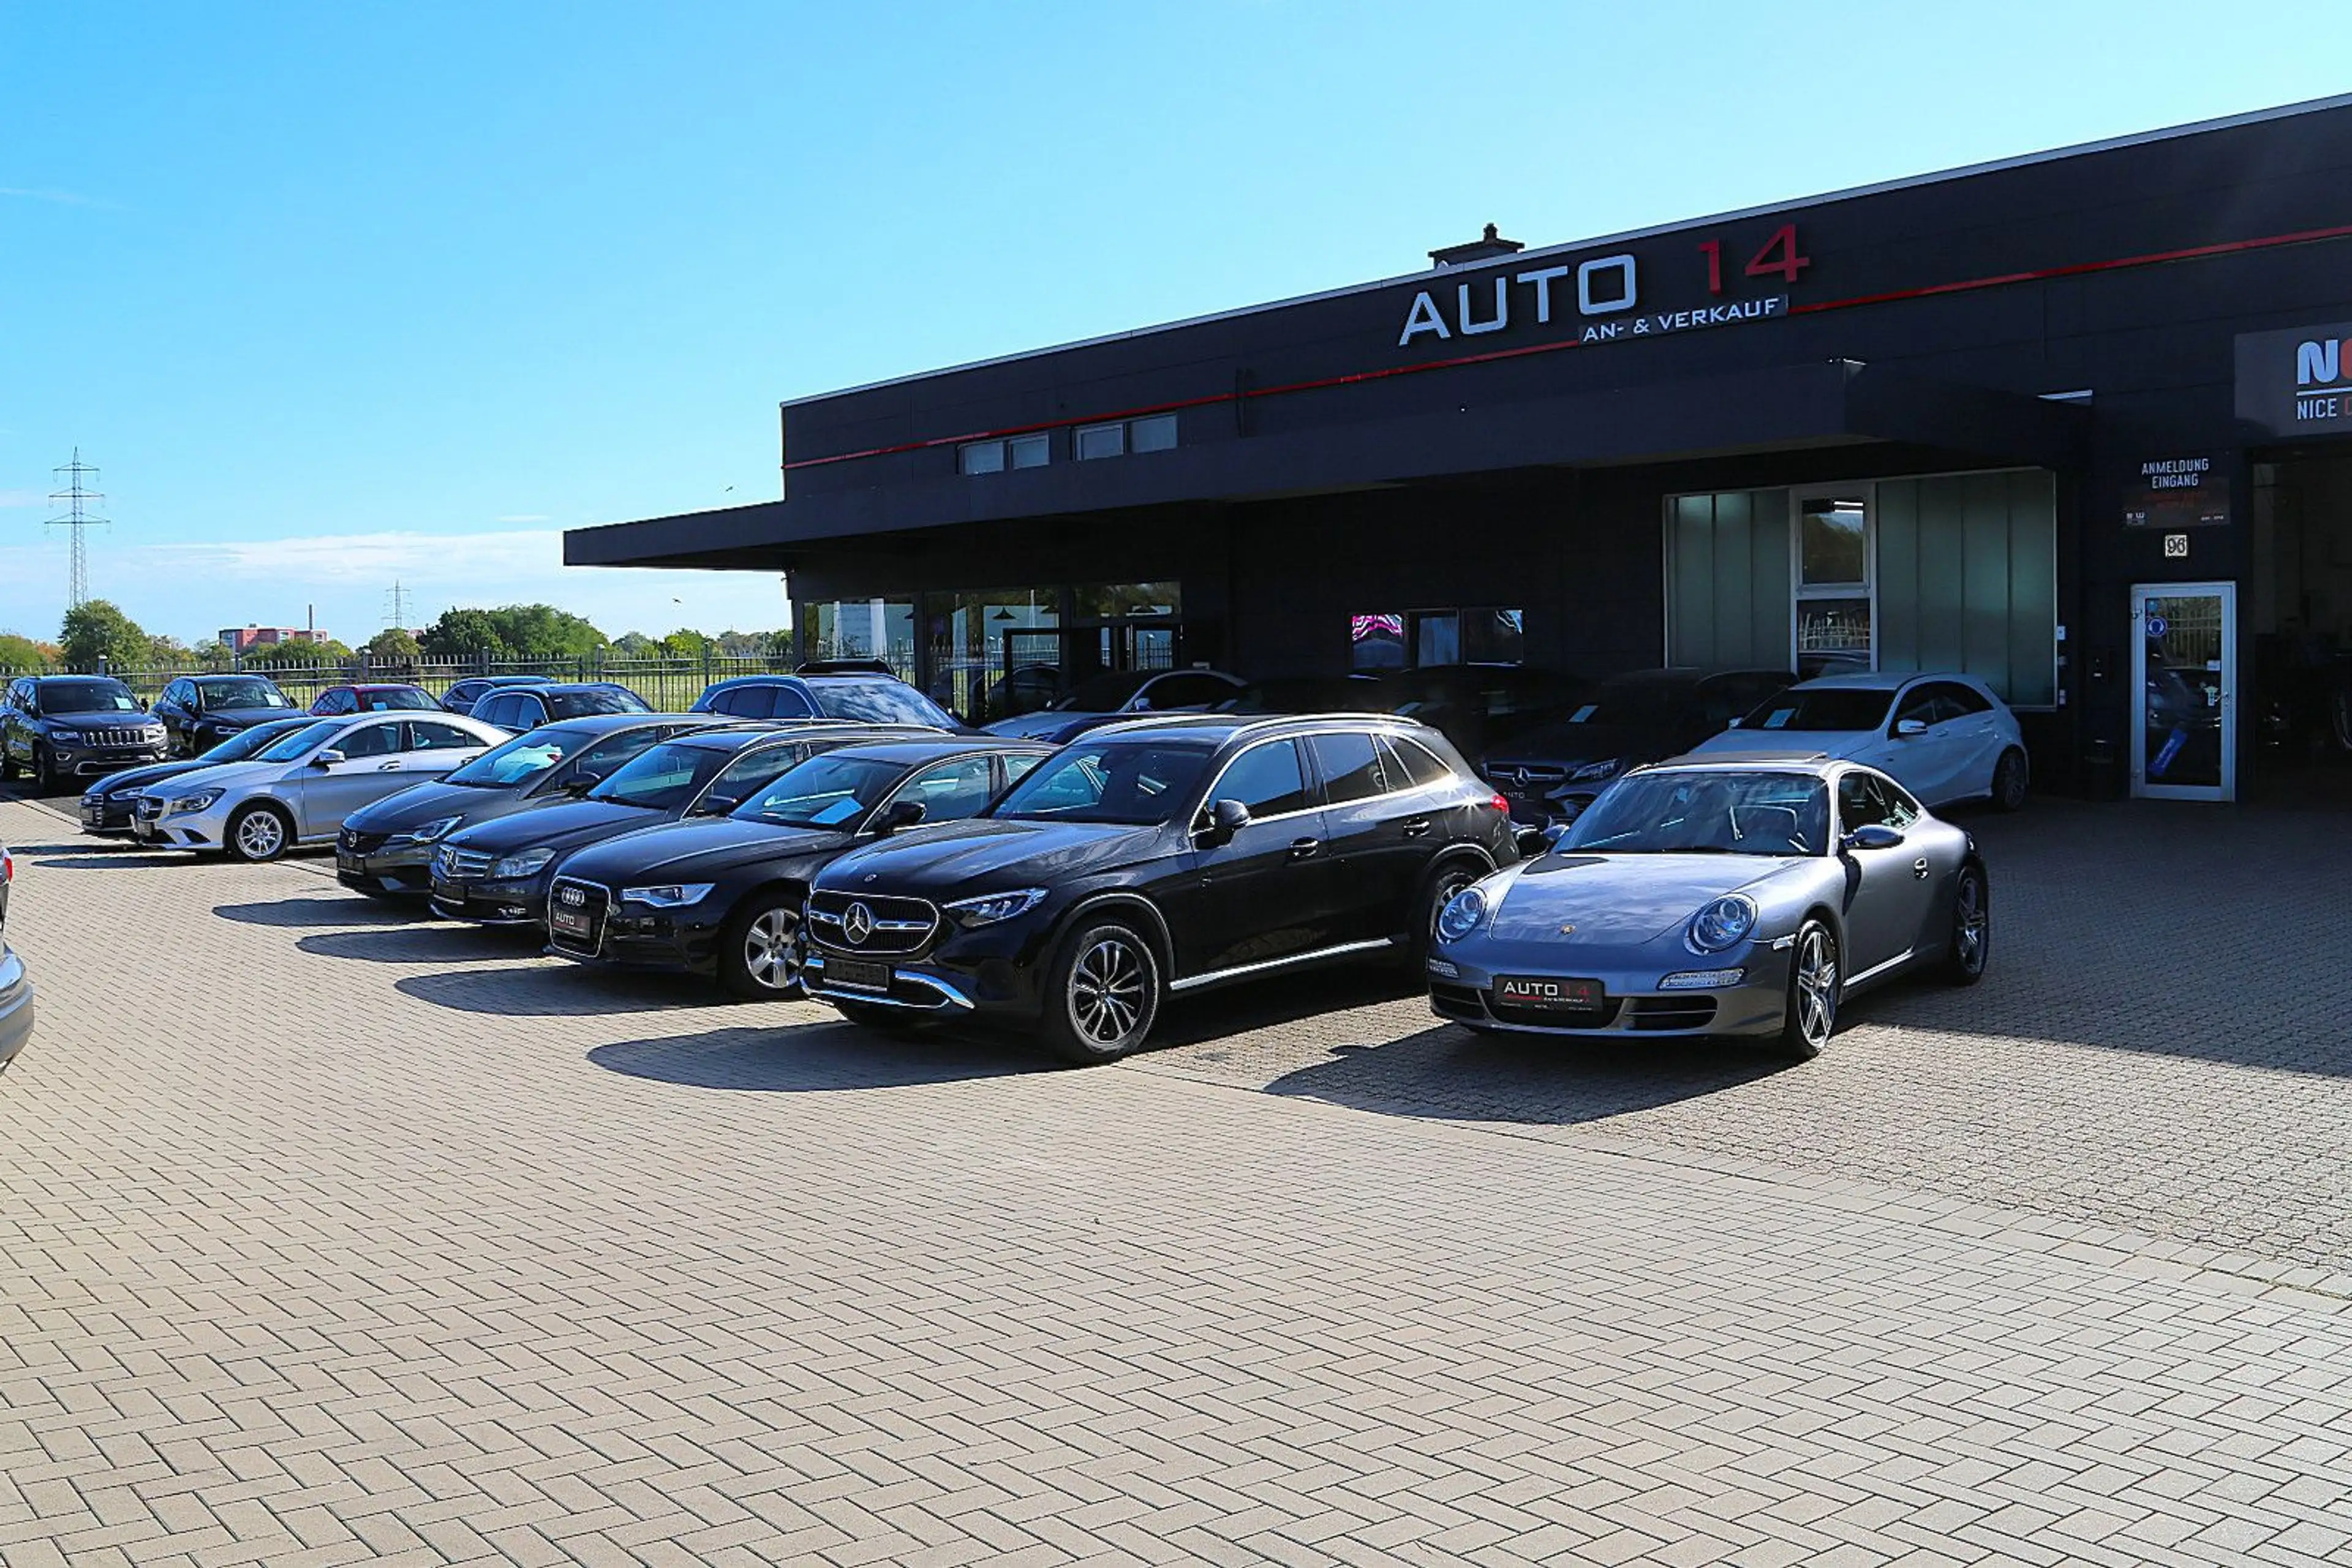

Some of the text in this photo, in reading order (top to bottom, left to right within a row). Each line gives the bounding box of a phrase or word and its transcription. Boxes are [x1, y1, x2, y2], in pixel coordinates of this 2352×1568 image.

[1397, 223, 1811, 347] AUTO 14
[1583, 298, 1780, 342] AN- & VERKAUF
[2297, 338, 2352, 385] N
[2297, 397, 2337, 420] NICE
[2141, 458, 2209, 476] ANMELDUNG
[2152, 473, 2199, 489] EINGANG
[2166, 537, 2186, 554] 96
[556, 912, 575, 925] AUTO
[1504, 981, 1558, 996] AUTO
